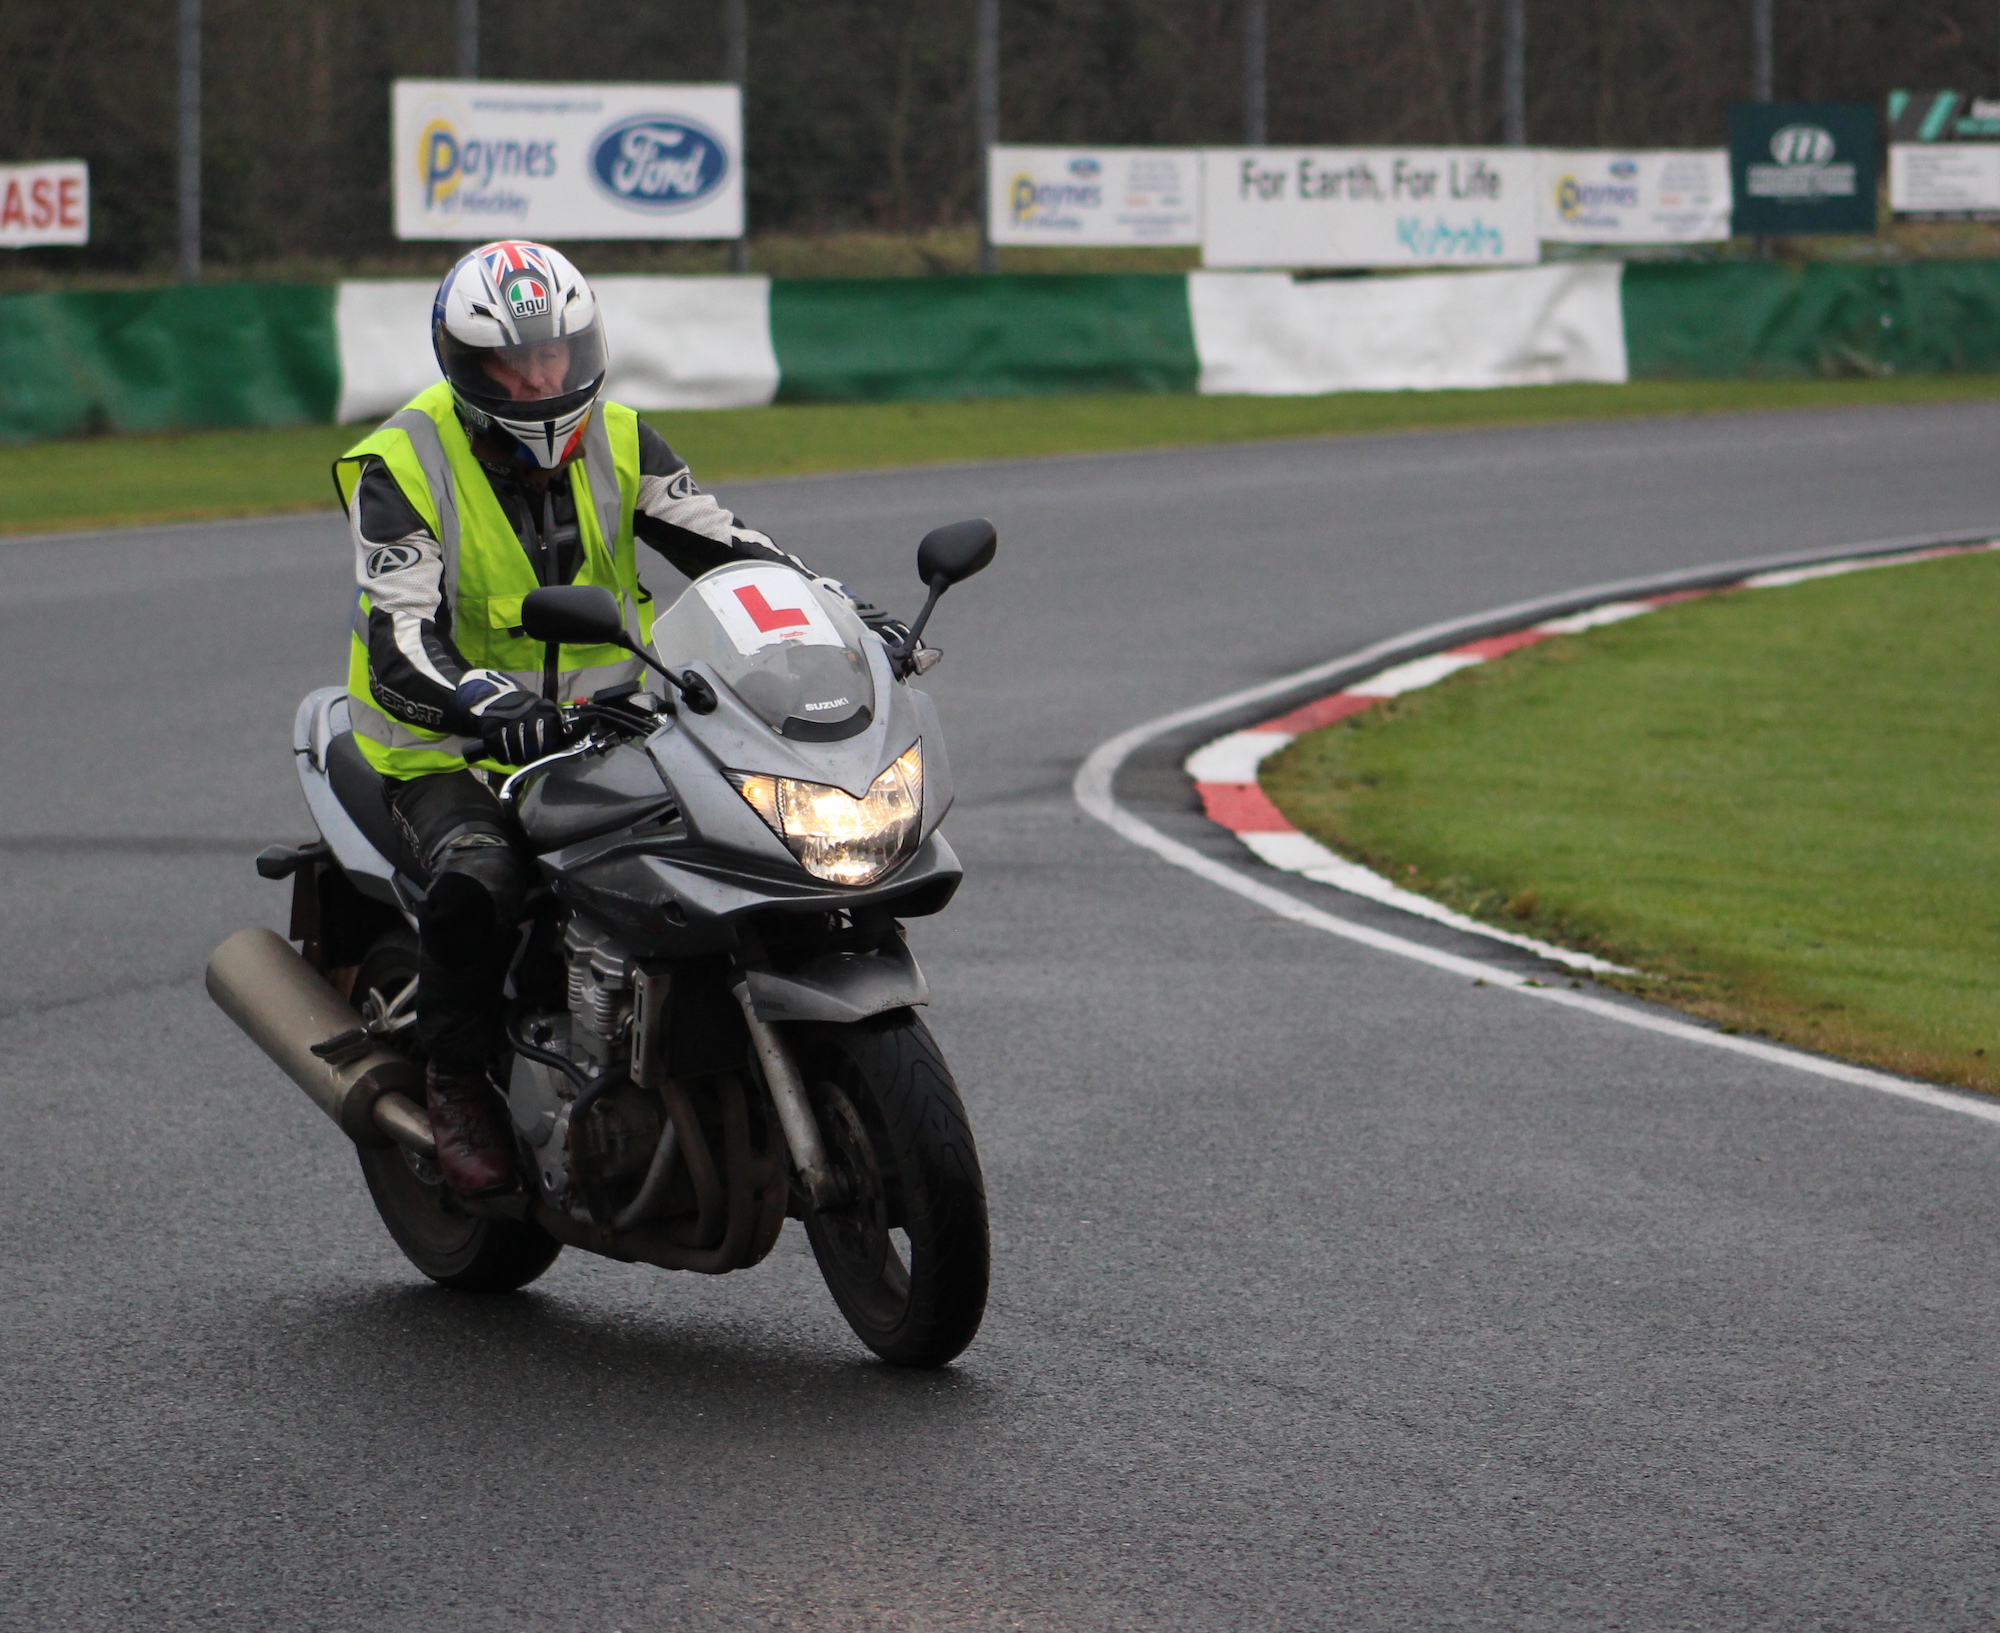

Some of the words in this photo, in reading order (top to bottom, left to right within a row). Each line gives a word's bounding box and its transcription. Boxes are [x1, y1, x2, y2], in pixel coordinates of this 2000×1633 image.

[424, 130, 559, 212] Paynes
[611, 125, 707, 197] Ford
[1240, 157, 1286, 201] For
[1298, 157, 1384, 204] Earth,
[1392, 157, 1437, 201] For
[1449, 157, 1502, 201] Life
[1, 178, 83, 229] ASE
[516, 298, 545, 315] agv
[732, 584, 811, 633] L
[805, 697, 849, 712] SUZUKI
